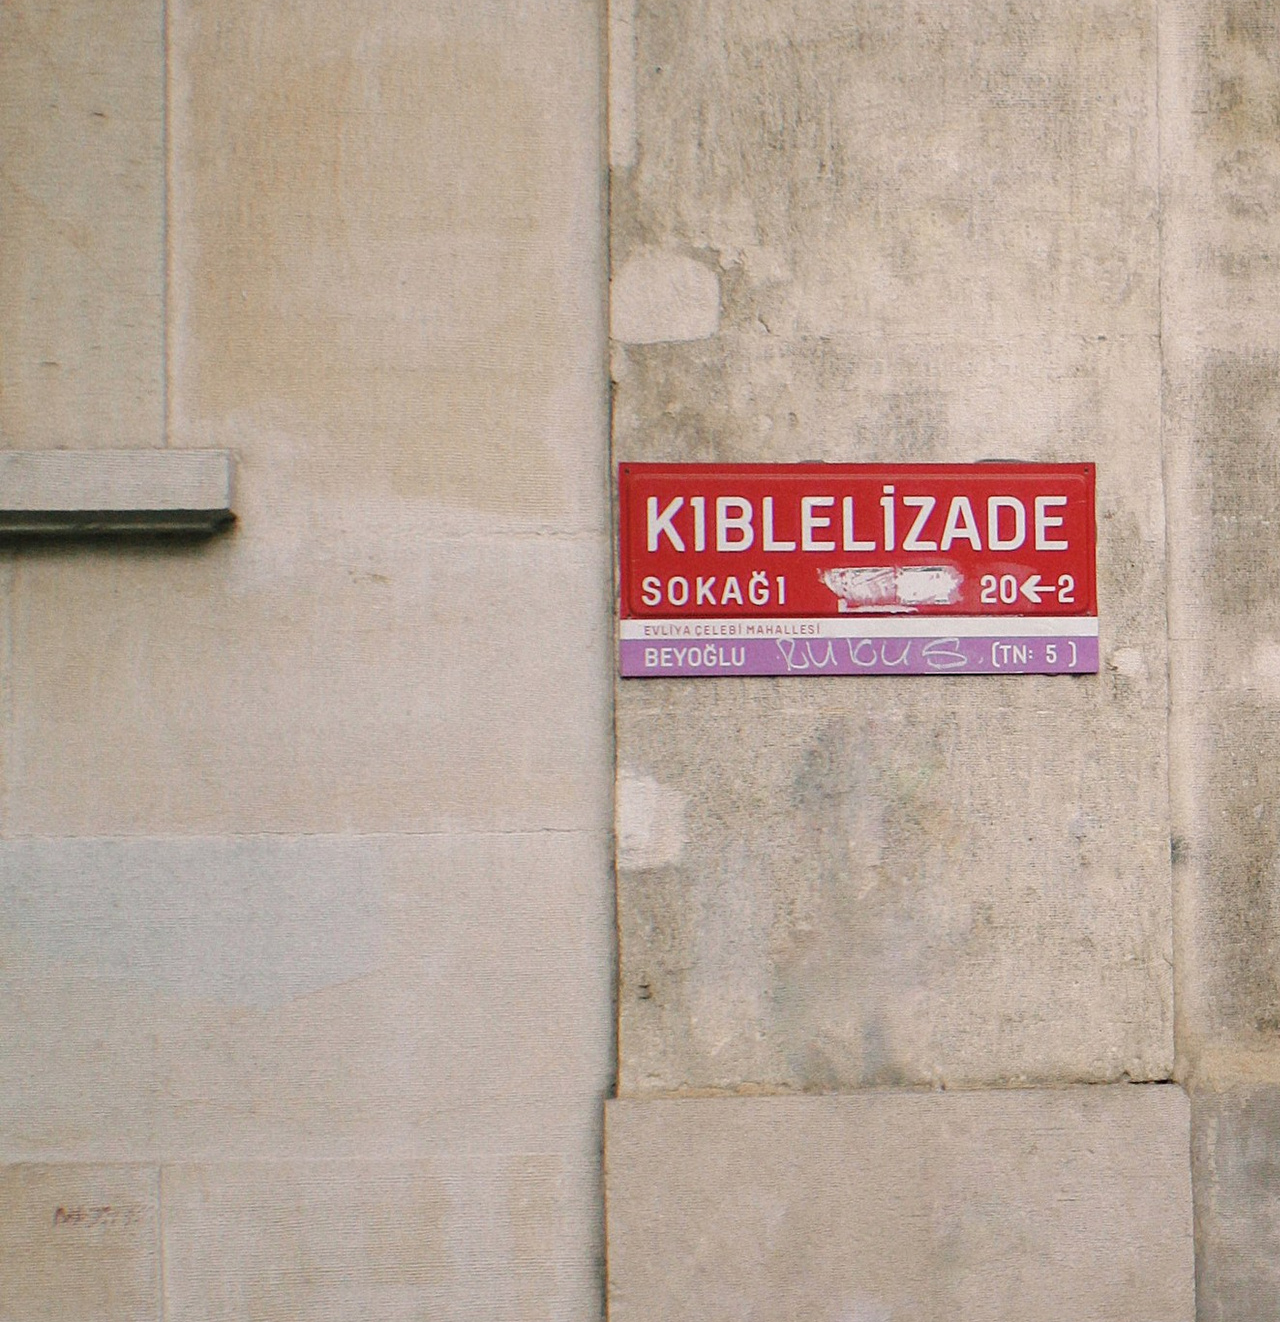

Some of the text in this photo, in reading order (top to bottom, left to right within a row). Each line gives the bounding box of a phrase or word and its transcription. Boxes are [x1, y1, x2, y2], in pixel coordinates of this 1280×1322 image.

[646, 484, 1069, 552] KIBLELİZADE
[642, 571, 1075, 606] SOKAĞI 20 2
[643, 623, 821, 637] EVLİYA ÇELEBİ MAHALLESİ
[644, 643, 746, 667] BEYOĞLU
